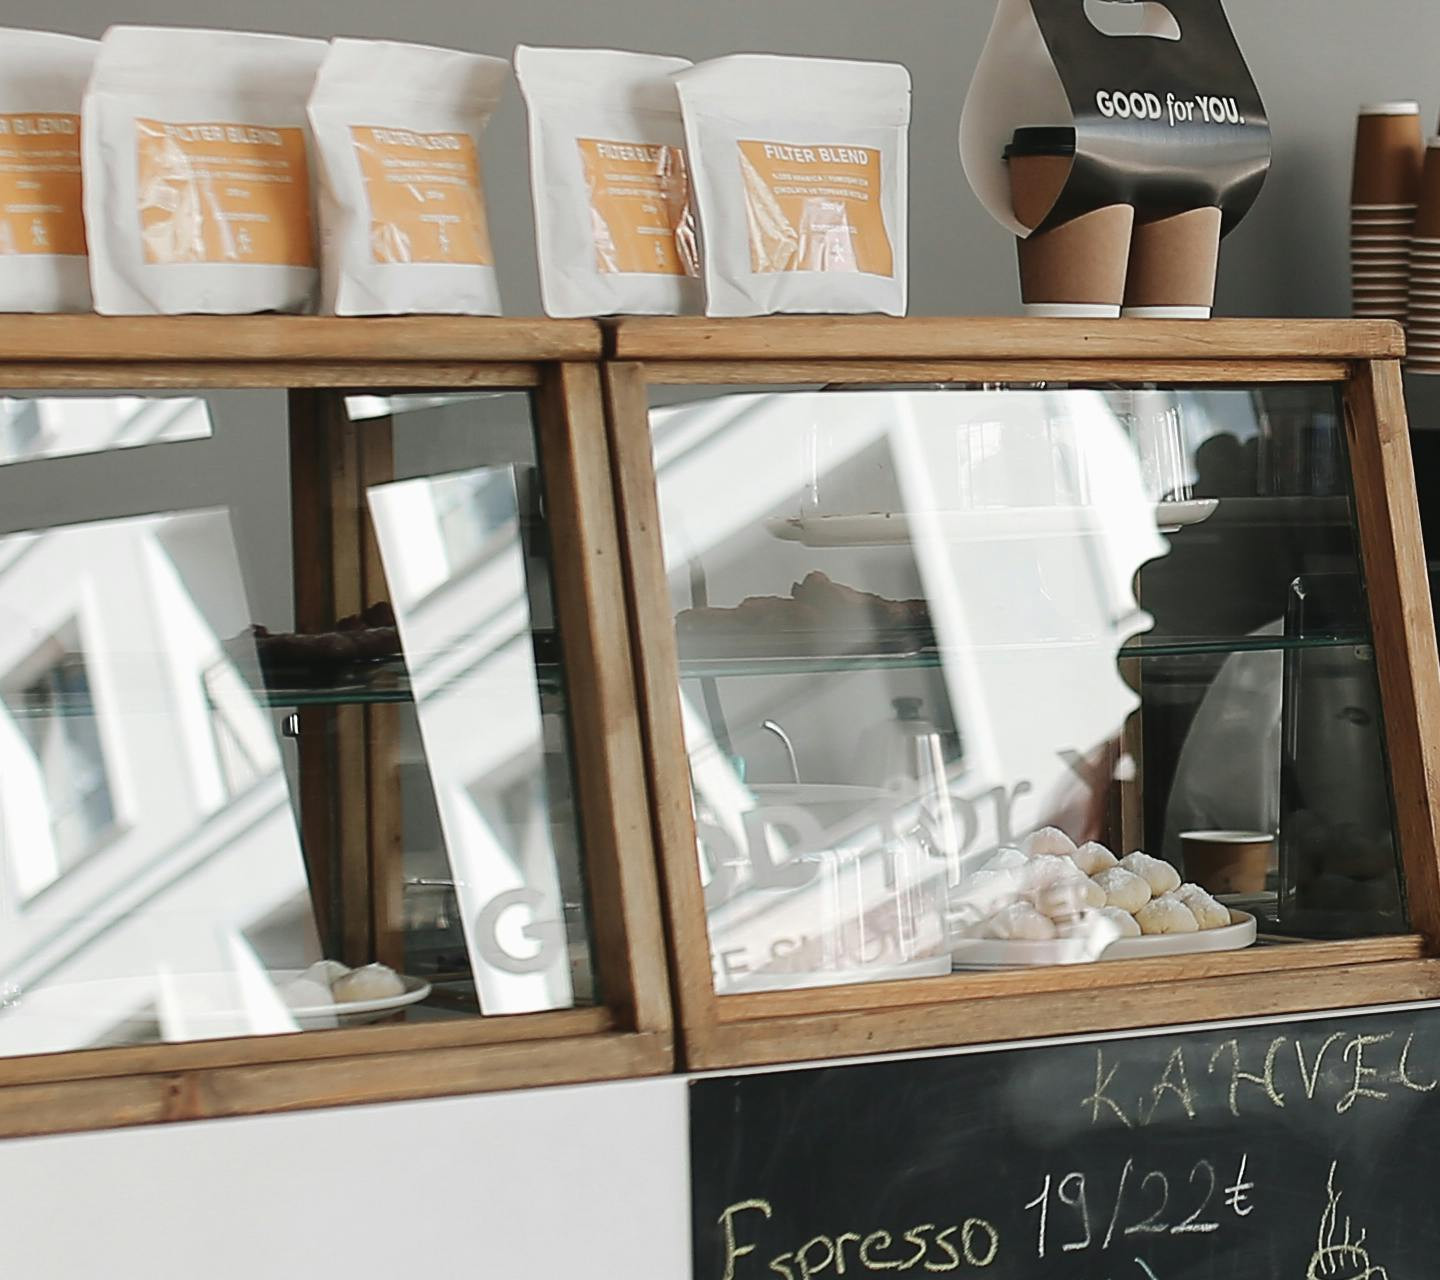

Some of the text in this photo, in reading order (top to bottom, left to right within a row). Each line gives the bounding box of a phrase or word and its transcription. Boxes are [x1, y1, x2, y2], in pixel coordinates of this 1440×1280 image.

[1096, 90, 1246, 127] GOOD for YOU.
[763, 144, 869, 165] FILTER BLEND
